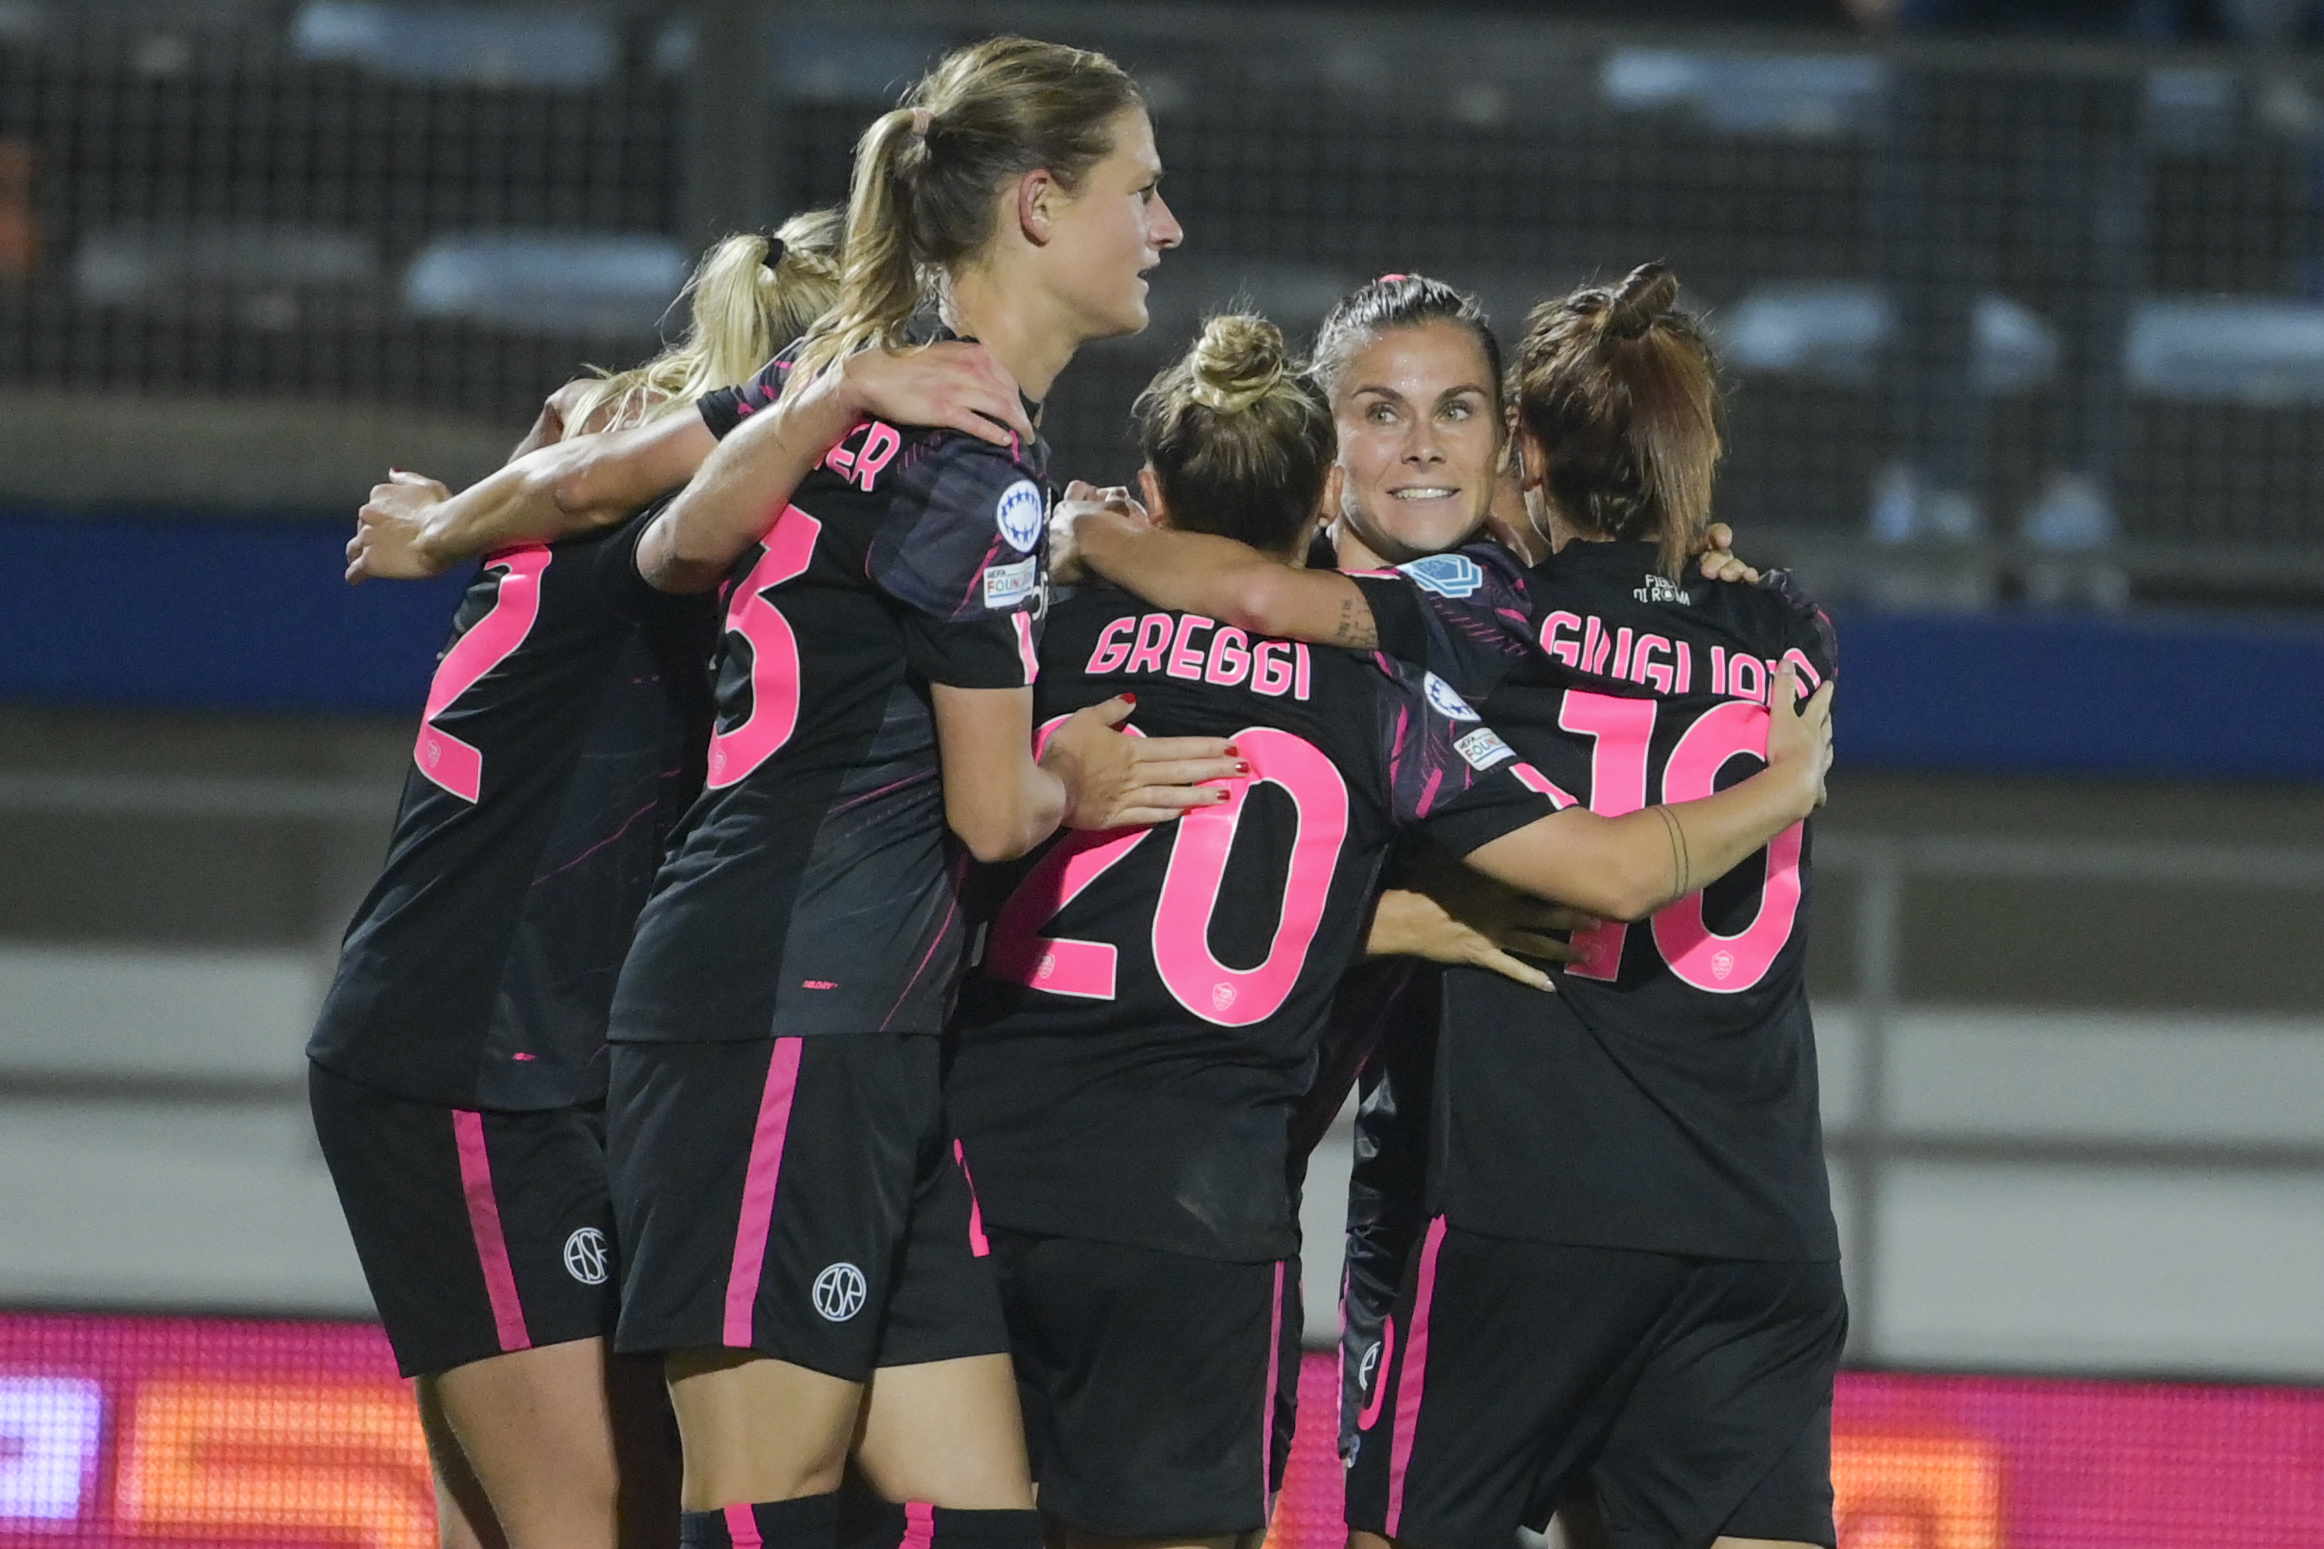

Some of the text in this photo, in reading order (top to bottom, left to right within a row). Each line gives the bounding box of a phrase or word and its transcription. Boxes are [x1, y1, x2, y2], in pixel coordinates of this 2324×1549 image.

[813, 420, 901, 492] ER
[1084, 612, 1311, 701] GREGGI
[986, 713, 1350, 1028] 20
[1559, 688, 1805, 994] 10
[812, 1262, 867, 1322] ASR
